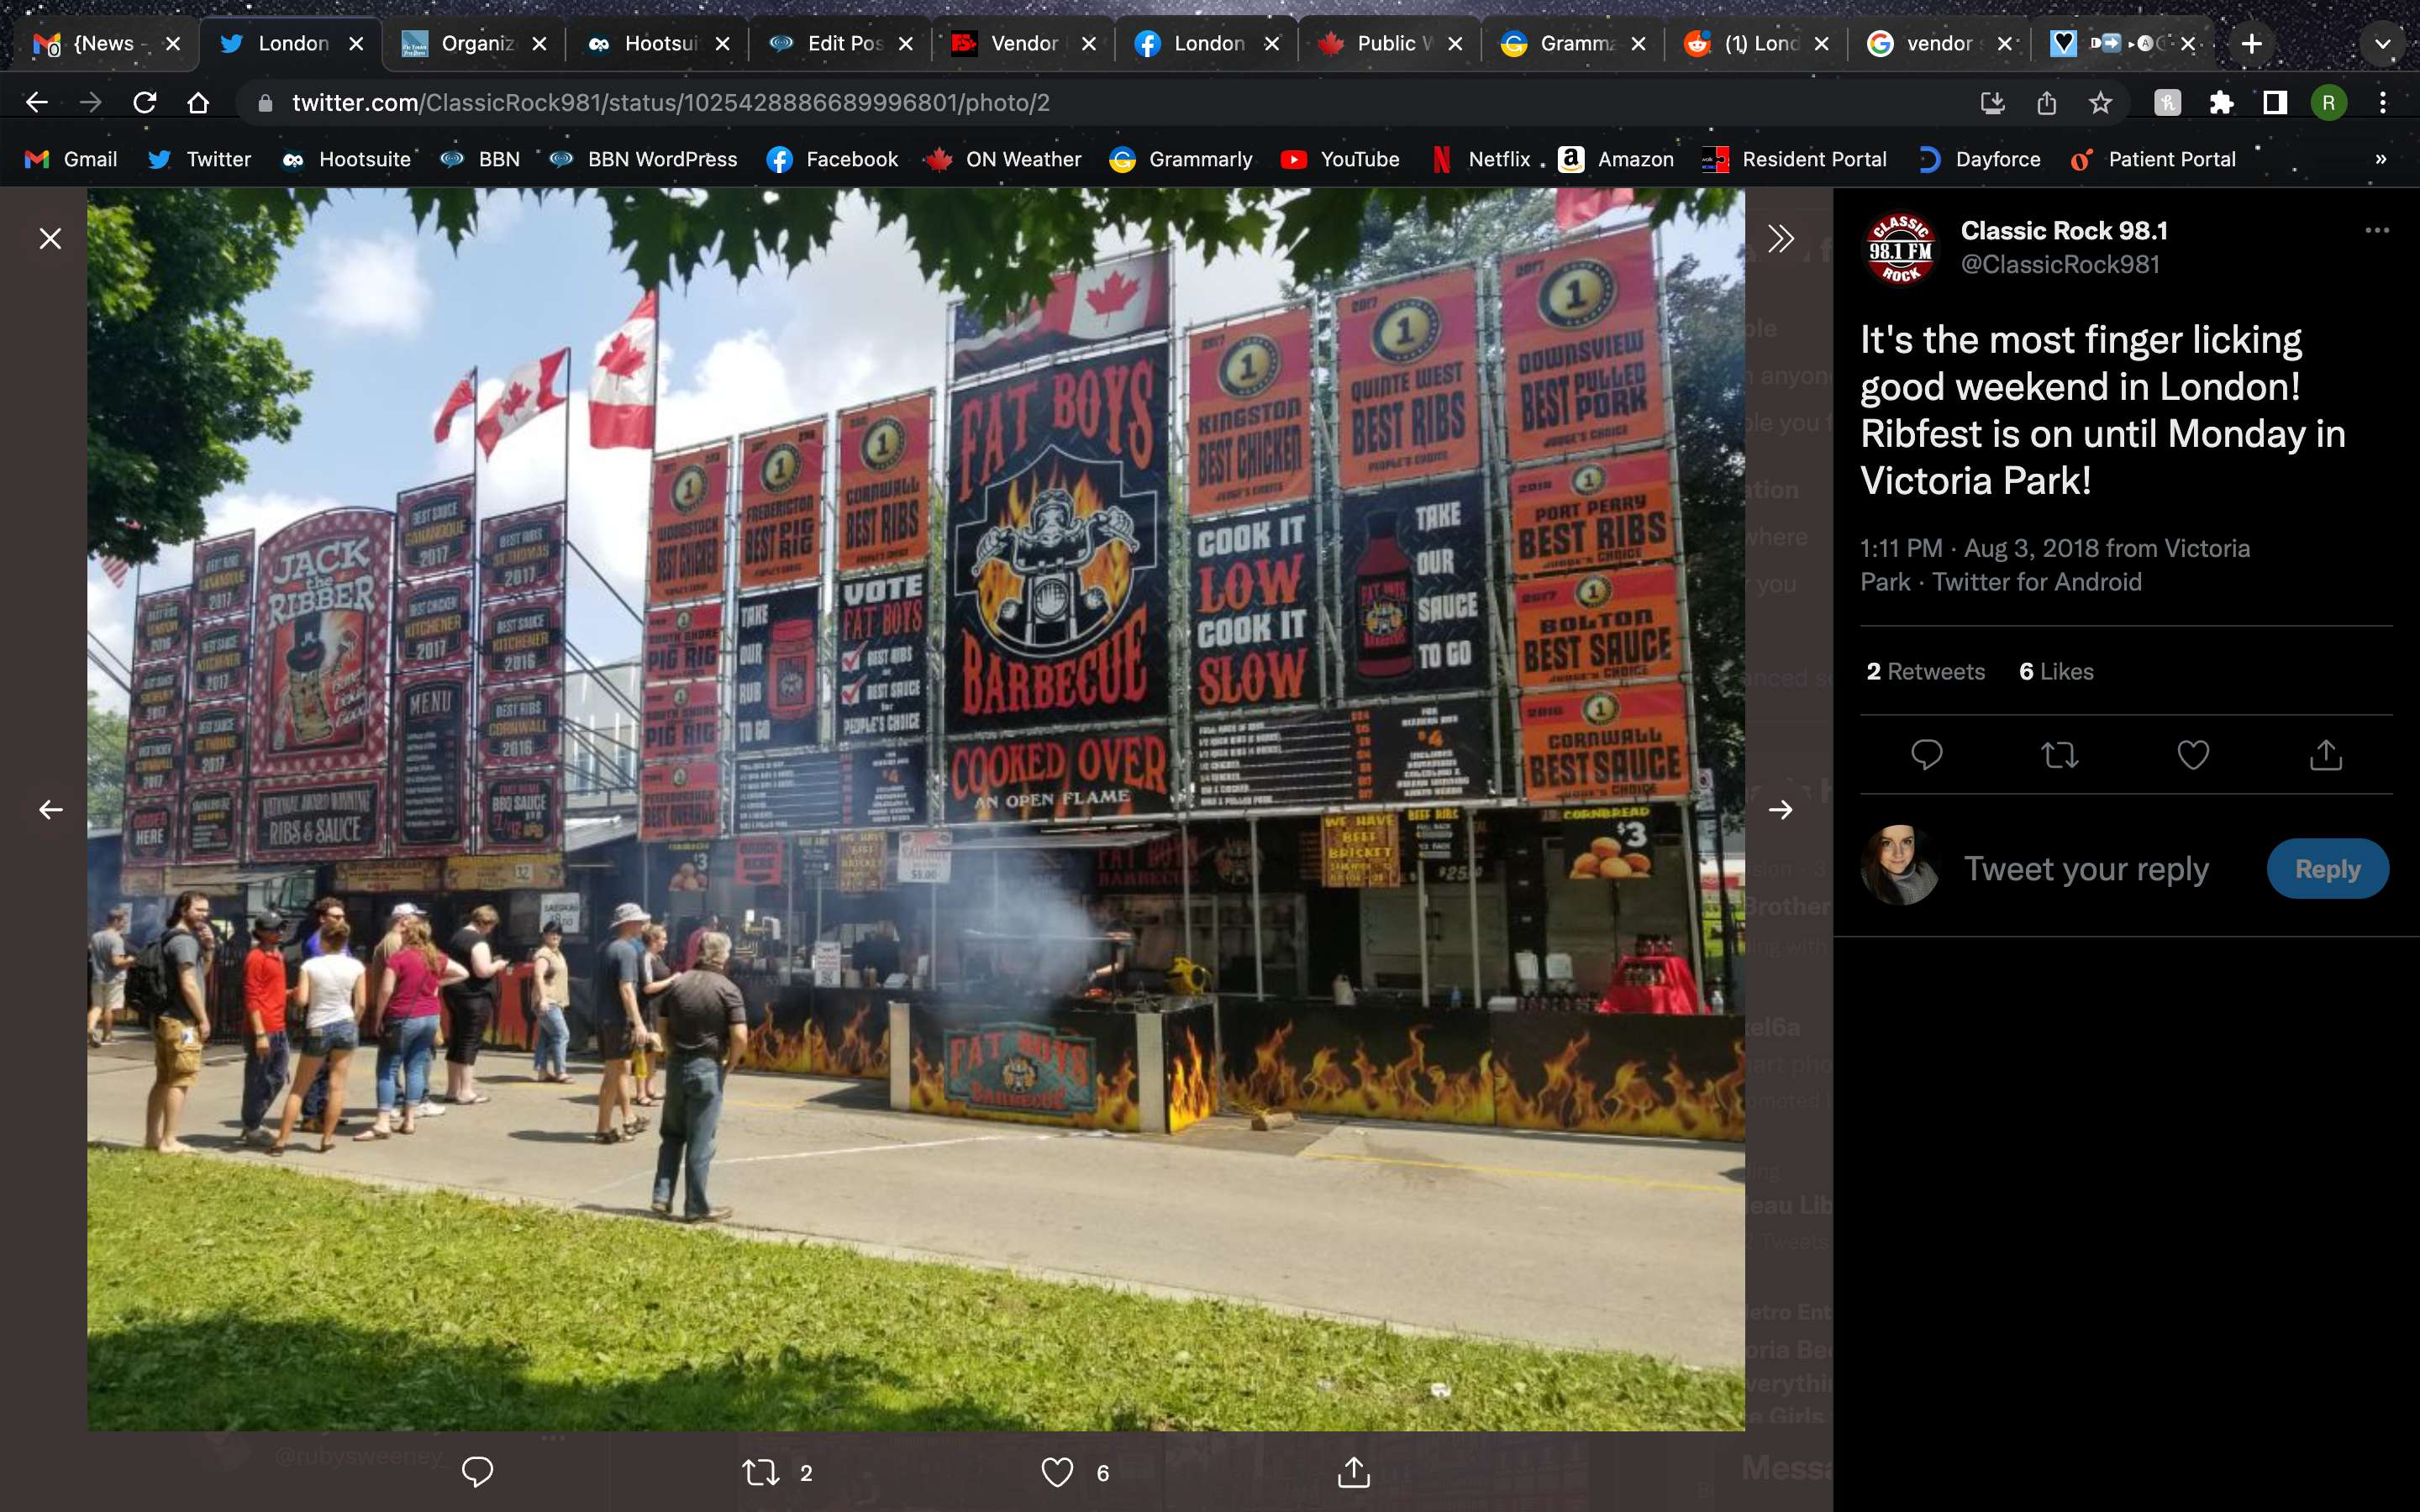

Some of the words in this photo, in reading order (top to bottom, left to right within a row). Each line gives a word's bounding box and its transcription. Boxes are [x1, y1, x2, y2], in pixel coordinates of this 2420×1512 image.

[74, 35, 134, 54] {News
[259, 35, 329, 51] London
[809, 35, 844, 51] Edit
[852, 35, 884, 51] Pos
[992, 35, 1059, 51] Vendor
[1176, 35, 1245, 51] London
[1359, 34, 1417, 51] Public
[1726, 34, 1748, 54] (1)
[1907, 35, 1973, 51] vendor
[292, 92, 1050, 116] twitter.com/ClassicRock981/status/1025428886689996801/photo/2
[2323, 94, 2335, 111] R
[64, 150, 117, 168] Gmail
[187, 150, 252, 167] Twitter
[320, 150, 411, 167] Hootsuite
[480, 150, 520, 167] BBN
[589, 150, 629, 167] BBN
[635, 150, 738, 167] WordPress
[808, 150, 899, 167] Facebook
[966, 150, 997, 168] ON
[1002, 150, 1082, 167] Weather
[1150, 150, 1254, 171] Grammarly
[1321, 150, 1400, 167] YouTube
[1470, 150, 1531, 167] Netflix
[1598, 151, 1674, 167] Amazon
[1744, 150, 1818, 167] Resident
[1833, 150, 1886, 167] Portal
[1957, 150, 2041, 171] Dayforce
[2110, 150, 2167, 167] Patient
[2181, 150, 2236, 167] Portal
[1874, 216, 1929, 238] CLASSIC
[1961, 220, 2047, 241] Classic
[2054, 220, 2113, 241] Rock
[2119, 220, 2167, 241] 98.1
[1870, 243, 1902, 260] 98.1
[1908, 243, 1932, 260] FM
[1883, 267, 1922, 282] ROCK
[1961, 254, 2159, 275] @ClassicRock981
[1518, 329, 1644, 375] DOWNSVIEW
[1862, 324, 1913, 354] It's
[1923, 323, 1979, 354] the
[1991, 327, 2075, 354] most
[2085, 323, 2184, 362] finger
[2194, 323, 2303, 362] licking
[1352, 372, 1410, 402] QUINTE
[1416, 362, 1464, 387] WEST
[1860, 370, 1944, 409] good
[1955, 370, 2108, 402] weekend
[2120, 371, 2149, 401] in
[2161, 370, 2300, 402] London!
[1520, 375, 1570, 433] BEST
[1575, 361, 1646, 396] PULLED
[1576, 386, 1648, 422] PORK
[1198, 396, 1301, 435] KINGSTON
[1352, 401, 1403, 456] BEST
[1412, 391, 1465, 449] RIBS
[958, 381, 1039, 503] FAT
[1053, 358, 1155, 470] BOYS
[1590, 424, 1628, 440] CHOICE
[1862, 417, 1982, 449] Ribfest
[1993, 418, 2020, 449] is
[2030, 426, 2072, 449] on
[2084, 417, 2156, 449] until
[2170, 417, 2307, 455] Monday
[2317, 418, 2345, 448] in
[1198, 437, 1233, 487] BEST
[1238, 425, 1302, 480] CHICKEN
[847, 476, 918, 506] CORNWALL
[1860, 465, 1992, 496] Victoria
[2005, 465, 2091, 496] Park!
[1416, 501, 1461, 531] TAKE
[1535, 502, 1581, 522] PORT
[1587, 495, 1646, 515] PERRY
[847, 507, 876, 549] BEST
[881, 499, 918, 545] RIBS
[744, 526, 776, 565] BEST
[780, 517, 814, 538] PIG
[1197, 522, 1270, 558] COOK
[1280, 516, 1306, 546] IT
[1518, 520, 1587, 560] BEST
[1598, 511, 1666, 550] RIBS
[420, 546, 449, 568] 2017
[780, 536, 813, 559] RIG
[1598, 547, 1642, 562] CHOICE
[1860, 538, 1898, 558] 1:11
[1907, 538, 1943, 558] PM
[1964, 538, 2008, 563] Aug
[2014, 538, 2035, 561] 3,
[2043, 538, 2100, 558] 2018
[2106, 538, 2158, 558] from
[2165, 538, 2251, 558] Victoria
[273, 537, 370, 585] JACK
[1417, 549, 1454, 575] OUR
[306, 575, 334, 590] the
[505, 566, 536, 586] 2017
[1197, 553, 1305, 614] LOW
[1861, 571, 1912, 591] Park
[1932, 571, 2011, 591] Twitter
[2016, 571, 2049, 591] for
[2054, 571, 2142, 591] Android
[844, 574, 923, 606] VOTE
[269, 575, 376, 630] RIBBER
[1418, 592, 1478, 622] SAUCE
[741, 604, 768, 627] TAKE
[843, 605, 876, 642] FAT
[884, 599, 923, 635] BOYS
[1539, 609, 1653, 633] BOLTON
[1197, 617, 1270, 648] COOK
[1280, 609, 1307, 639] IT
[417, 640, 446, 661] 2017
[739, 643, 763, 665] OUR
[963, 602, 1147, 715] BARBECUE
[1419, 643, 1442, 669] TO
[1446, 640, 1470, 666] GO
[1524, 634, 1581, 672] BEST
[1590, 627, 1671, 669] SAUCE
[1198, 648, 1307, 706] SLOW
[1866, 662, 1881, 680] 2
[1888, 662, 1986, 680] Retweets
[2019, 662, 2034, 681] 6
[2041, 661, 2095, 680] Likes
[410, 690, 451, 715] MENU
[739, 682, 762, 706] RUB
[887, 713, 921, 731] CHOICE
[502, 739, 534, 757] 2016
[1548, 727, 1662, 750] CORNWALL
[952, 742, 1066, 800] COOKED
[1077, 734, 1167, 795] OVER
[1530, 754, 1590, 789] BEST
[1593, 745, 1681, 785] SAUCE
[513, 794, 546, 811] SAUCE
[975, 795, 998, 809] AN
[1006, 793, 1054, 808] OPEN
[1063, 790, 1131, 805] FLAME
[1325, 816, 1347, 827] WE
[1356, 815, 1395, 827] HAVE
[1407, 810, 1431, 821] BEEF
[1435, 808, 1459, 819] RIBS
[1564, 806, 1650, 820] CORNBREAD
[135, 828, 164, 846] HERE
[270, 819, 301, 845] RIBS
[315, 816, 361, 843] SAUCE
[1343, 832, 1376, 842] BEEF
[1617, 822, 1647, 848] $3
[1964, 855, 2054, 882] Tweet
[2062, 862, 2128, 888] your
[2138, 854, 2210, 888] reply
[2296, 858, 2365, 884] Reply
[950, 1032, 1005, 1079] FAT
[1018, 1030, 1089, 1087] BOYS
[800, 1464, 813, 1482] 2
[1097, 1464, 1110, 1483] 6
